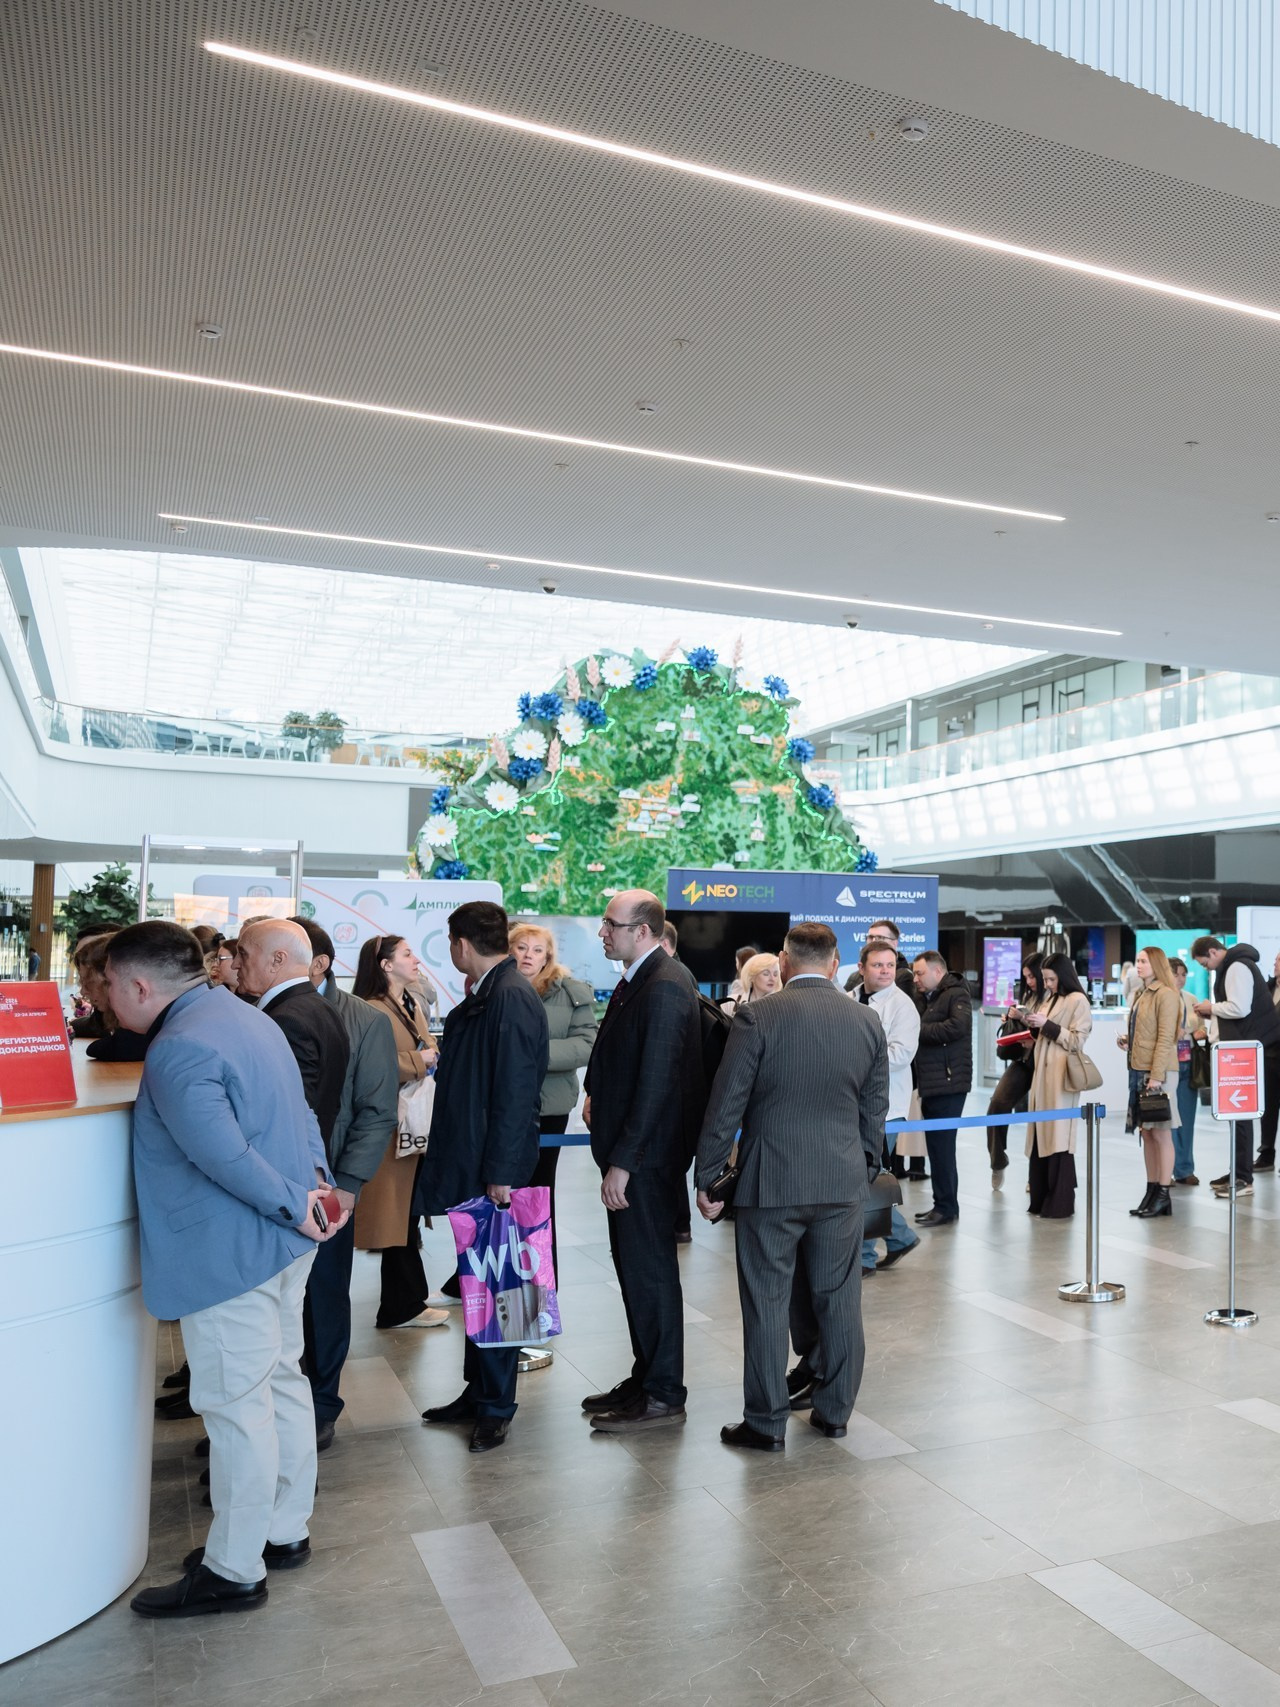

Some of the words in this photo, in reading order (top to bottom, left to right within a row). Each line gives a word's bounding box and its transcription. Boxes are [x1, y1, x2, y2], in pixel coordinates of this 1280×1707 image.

[706, 884, 775, 898] NEOTECH
[860, 890, 926, 898] SPECTRUM
[418, 901, 464, 910] АМПЛИ
[805, 914, 834, 923] ПОДХОД
[894, 916, 926, 924] ЛЕЧЕНИЮ
[853, 932, 867, 943] VE
[900, 932, 926, 943] Series
[0, 1035, 61, 1045] РЕГИСТРАЦИЯ
[0, 1044, 66, 1055] ДОКЛАДЧИКОВ
[400, 1132, 429, 1149] Be
[466, 1225, 541, 1282] wb
